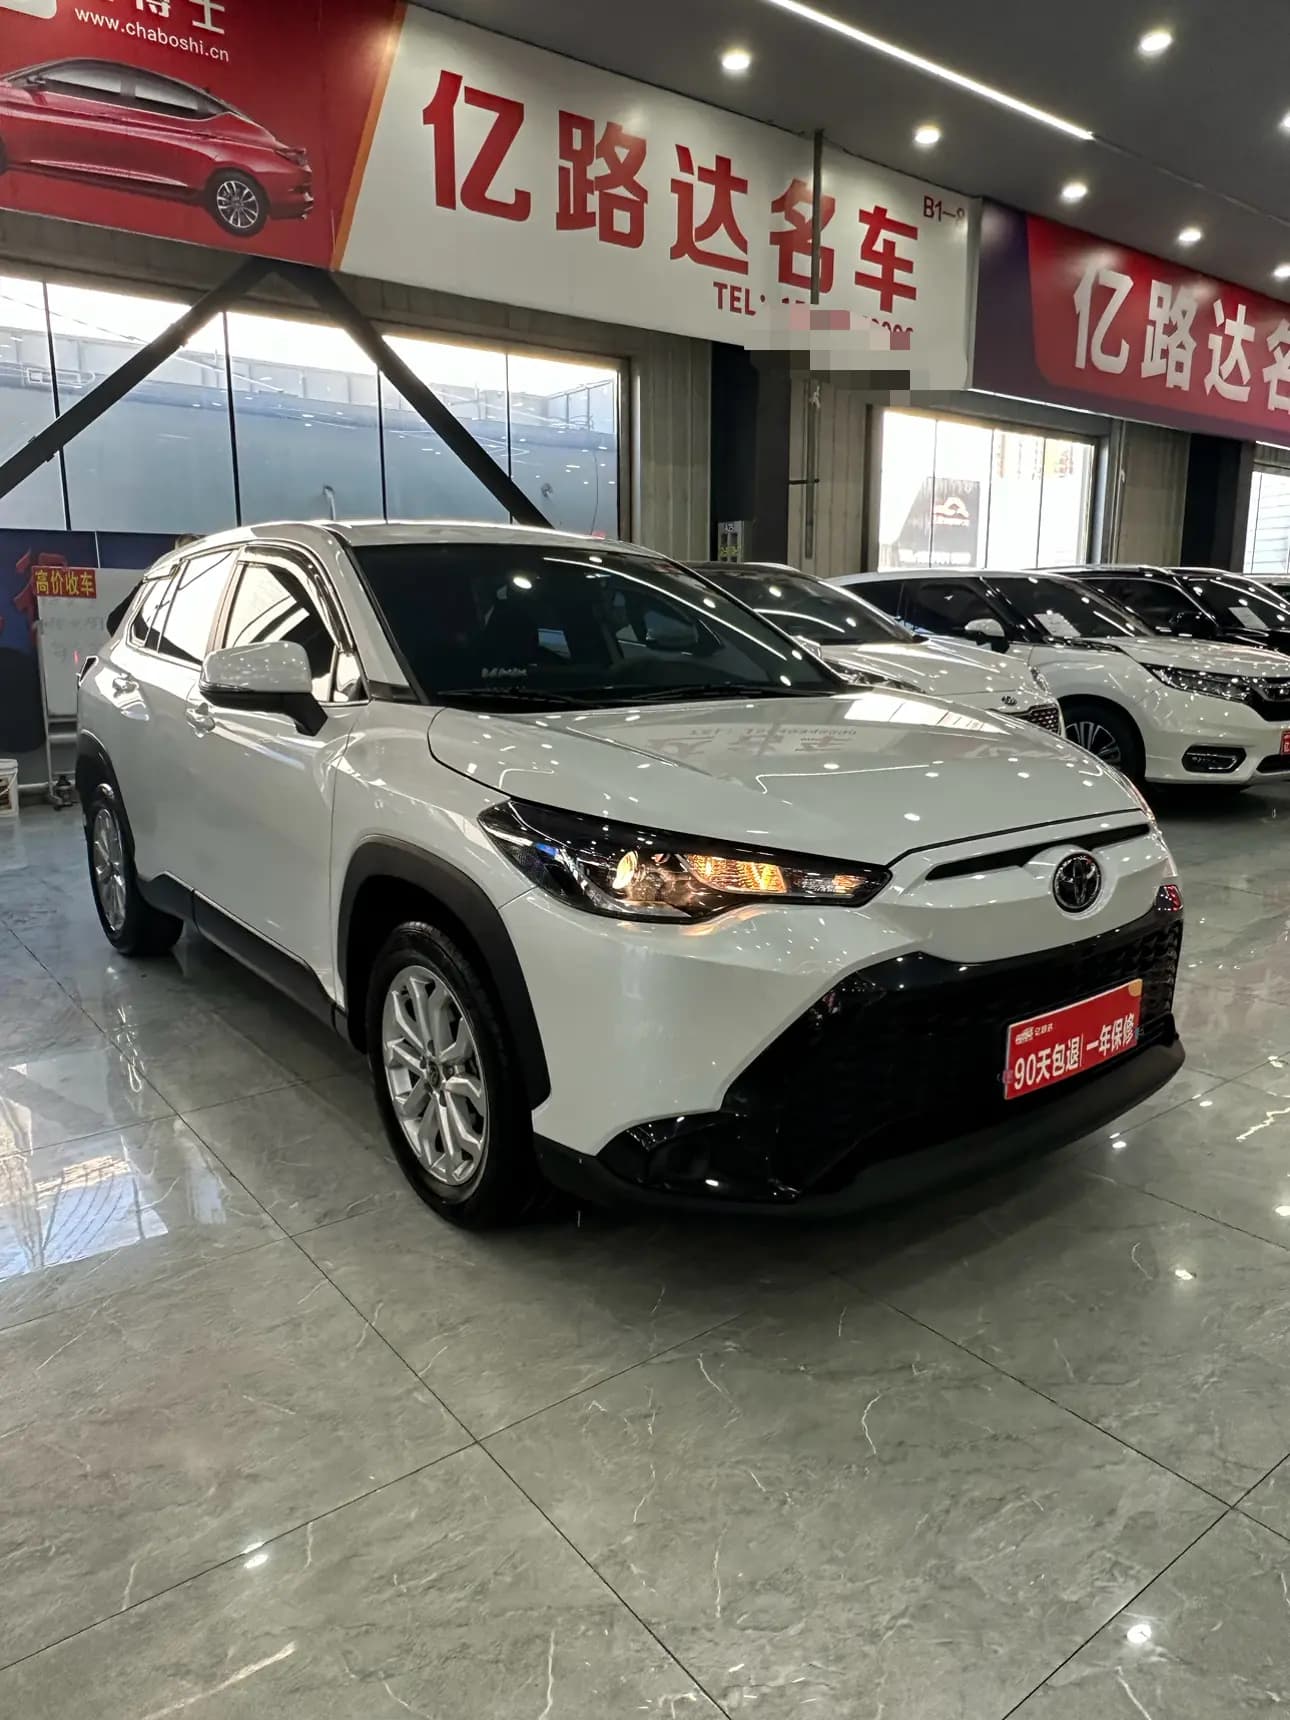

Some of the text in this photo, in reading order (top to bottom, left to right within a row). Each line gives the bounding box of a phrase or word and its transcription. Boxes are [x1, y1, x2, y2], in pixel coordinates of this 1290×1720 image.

[74, 8, 230, 62] www.chaboshi.cn
[422, 70, 919, 314] 亿路达名车
[35, 570, 95, 596] 高价收车
[1014, 1013, 1135, 1090] 90天包退 一年保修
